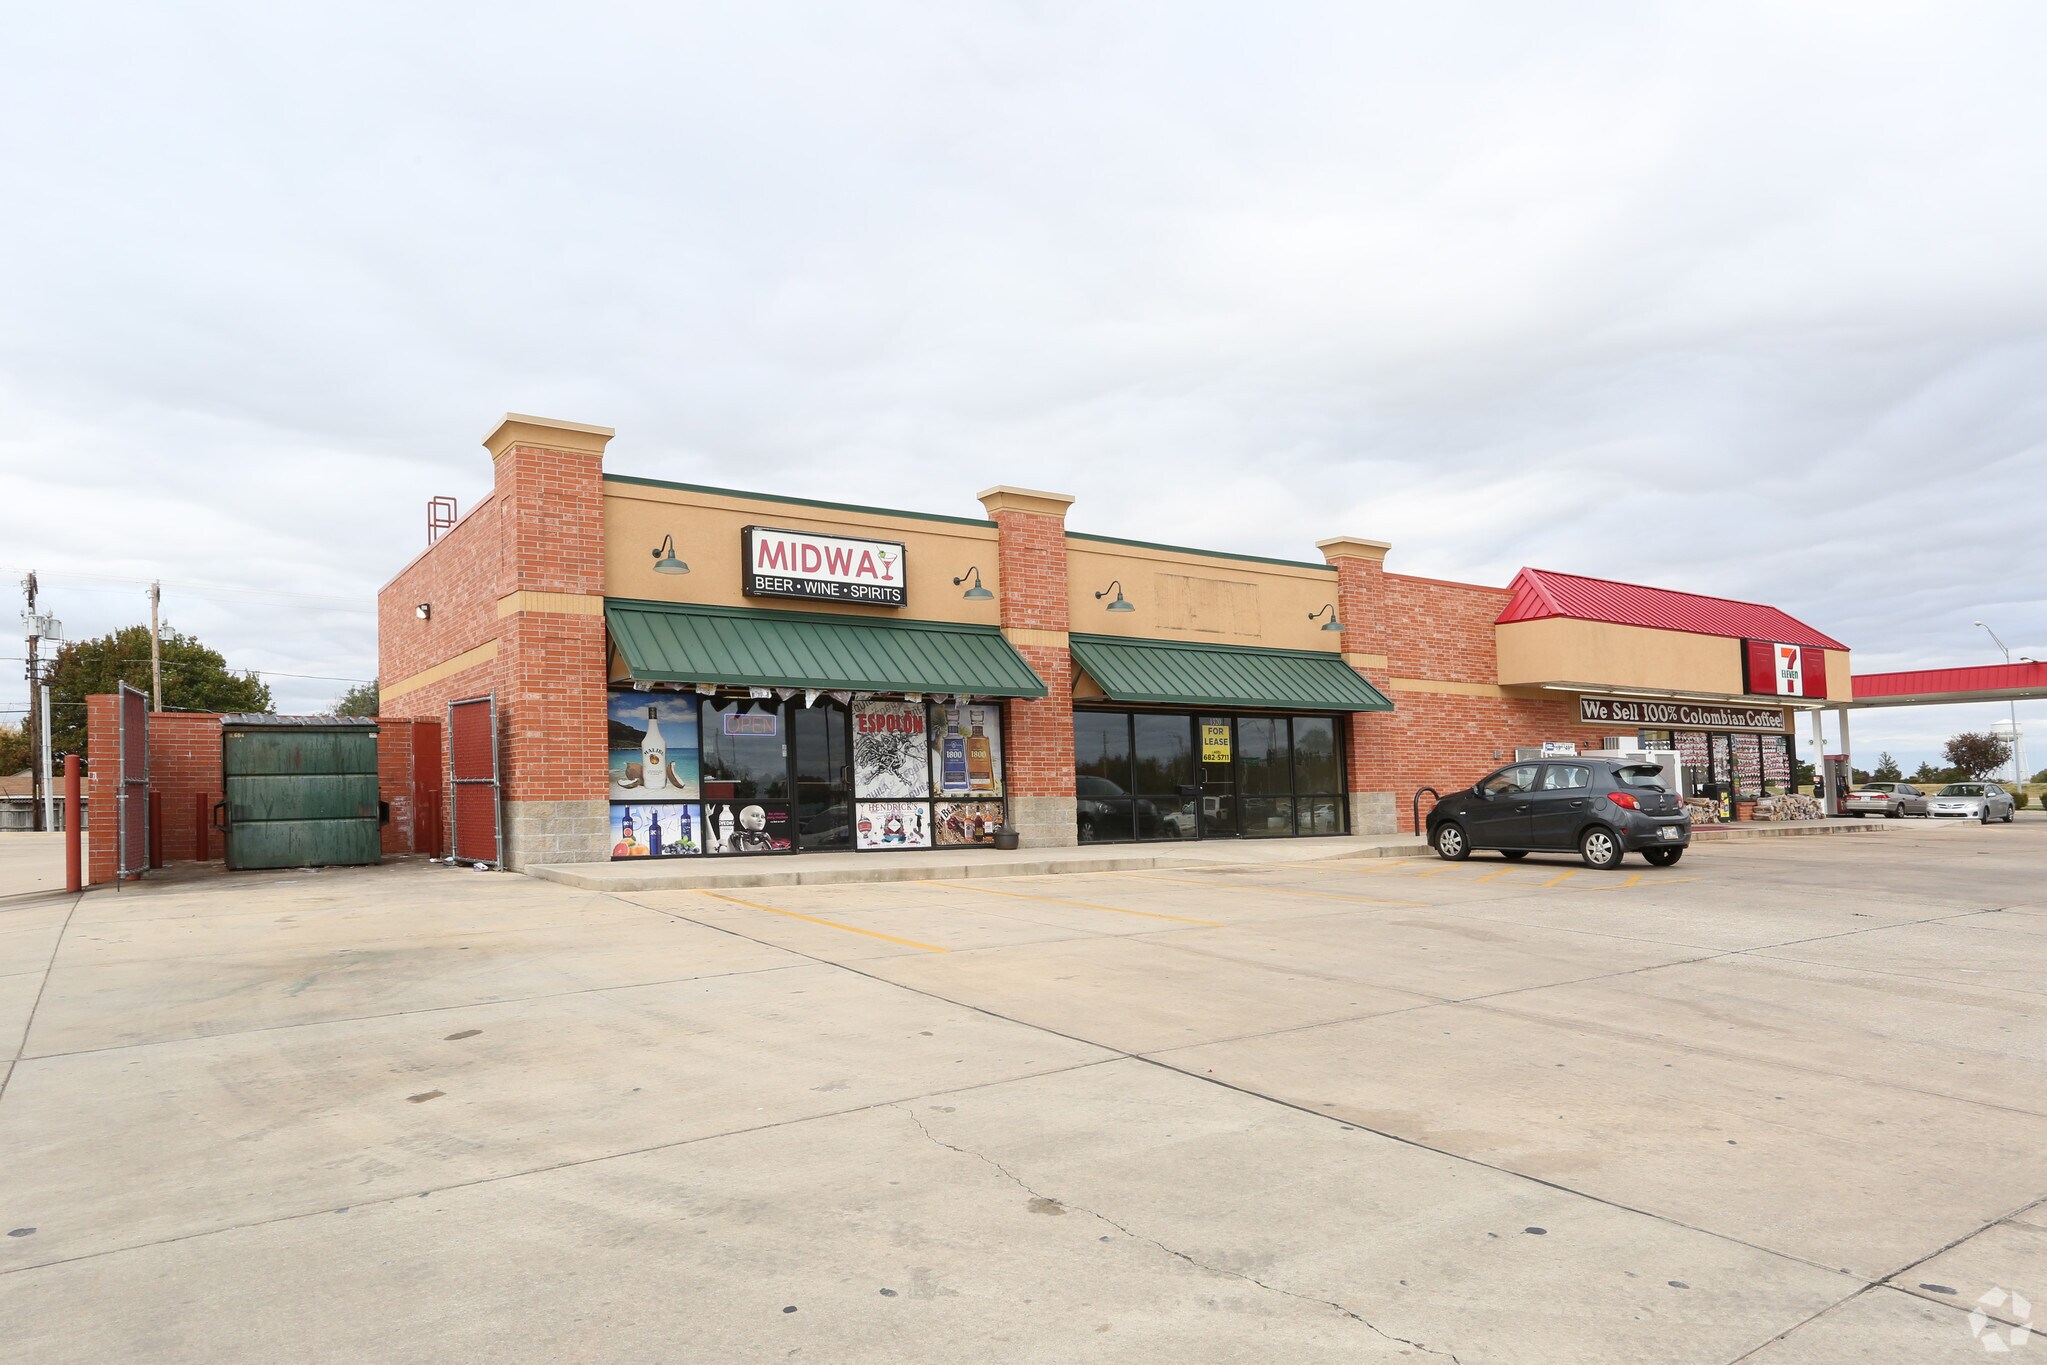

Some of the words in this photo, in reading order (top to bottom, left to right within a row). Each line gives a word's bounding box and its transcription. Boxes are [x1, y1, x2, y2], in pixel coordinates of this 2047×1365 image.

[755, 576, 794, 592] BEER
[804, 580, 840, 596] WINE
[850, 585, 901, 601] SPIRITS
[1781, 647, 1797, 693] 7
[1582, 700, 1608, 719] We
[1612, 702, 1639, 721] Sell
[1643, 703, 1678, 722] 100%
[1679, 706, 1746, 726] Colombian
[1746, 710, 1784, 728] Coffee!
[726, 716, 774, 733] OPEN
[1208, 727, 1224, 735] FOR
[1204, 738, 1229, 746] LEASE
[946, 750, 963, 759] 1800
[971, 750, 987, 758] 1800
[868, 803, 918, 812] HENDRICK'S
